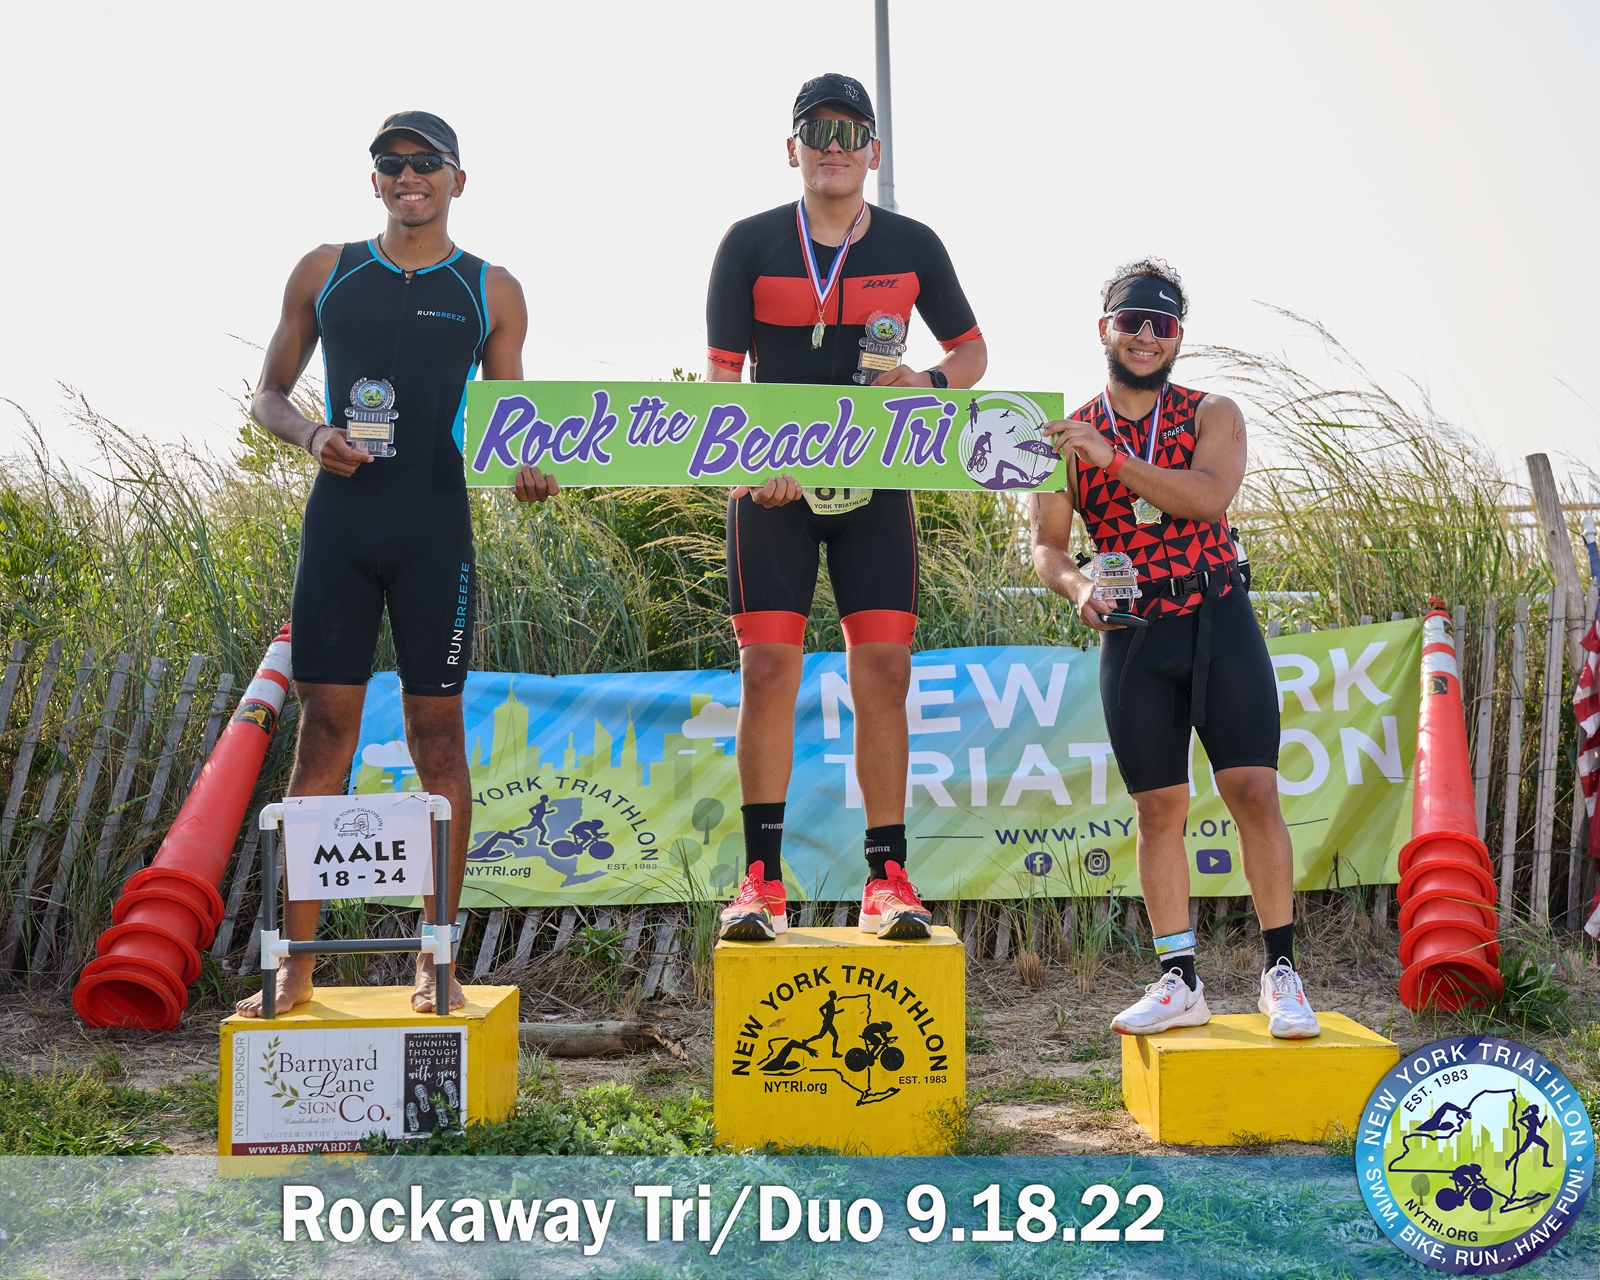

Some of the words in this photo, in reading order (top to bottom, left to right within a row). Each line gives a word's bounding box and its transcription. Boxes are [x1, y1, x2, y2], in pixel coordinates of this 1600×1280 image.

[417, 310, 467, 323] RUNBREEZE
[471, 389, 619, 474] Rock
[626, 395, 699, 447] the
[686, 396, 877, 478] Beach
[880, 394, 958, 468] Tri
[1163, 424, 1185, 440] SPARX
[834, 497, 868, 509] TRIATHLON
[446, 562, 470, 665] RUNBREEZE
[820, 663, 1070, 739] NEW
[1270, 641, 1393, 713] RK
[824, 715, 1404, 809] TRIATON
[339, 808, 356, 818] YORK
[357, 808, 384, 827] TRIATHLON
[472, 776, 543, 807] YORK
[555, 776, 659, 861] TRIATHLON
[995, 816, 1239, 845] www.NYI.or
[313, 840, 407, 865] MALE
[464, 865, 531, 878] NYTRI.org
[607, 863, 630, 871] EST.
[319, 871, 350, 887] 18
[374, 868, 406, 884] 24
[732, 1015, 764, 1076] NEW
[760, 966, 831, 1012] YORK
[841, 965, 948, 1072] TRIATHLON
[408, 1040, 457, 1048] RUNNING
[408, 1048, 458, 1057] THROUGH
[234, 1036, 246, 1097] SPONSOR
[278, 1049, 378, 1078] Barnyard
[435, 1057, 456, 1065] LIFE
[303, 1071, 375, 1098] Lane
[408, 1065, 433, 1081] with
[435, 1069, 458, 1087] you
[899, 1076, 921, 1085] EST.
[924, 1075, 947, 1084] 1983
[764, 1081, 827, 1095] NYTRI.org
[298, 1101, 336, 1115] SIGN
[339, 1094, 391, 1123] Co.
[234, 1101, 244, 1137] NYTRI
[284, 1117, 319, 1125] Established
[263, 1130, 330, 1139] QUOTEWORTHY
[334, 1129, 359, 1138] HOME
